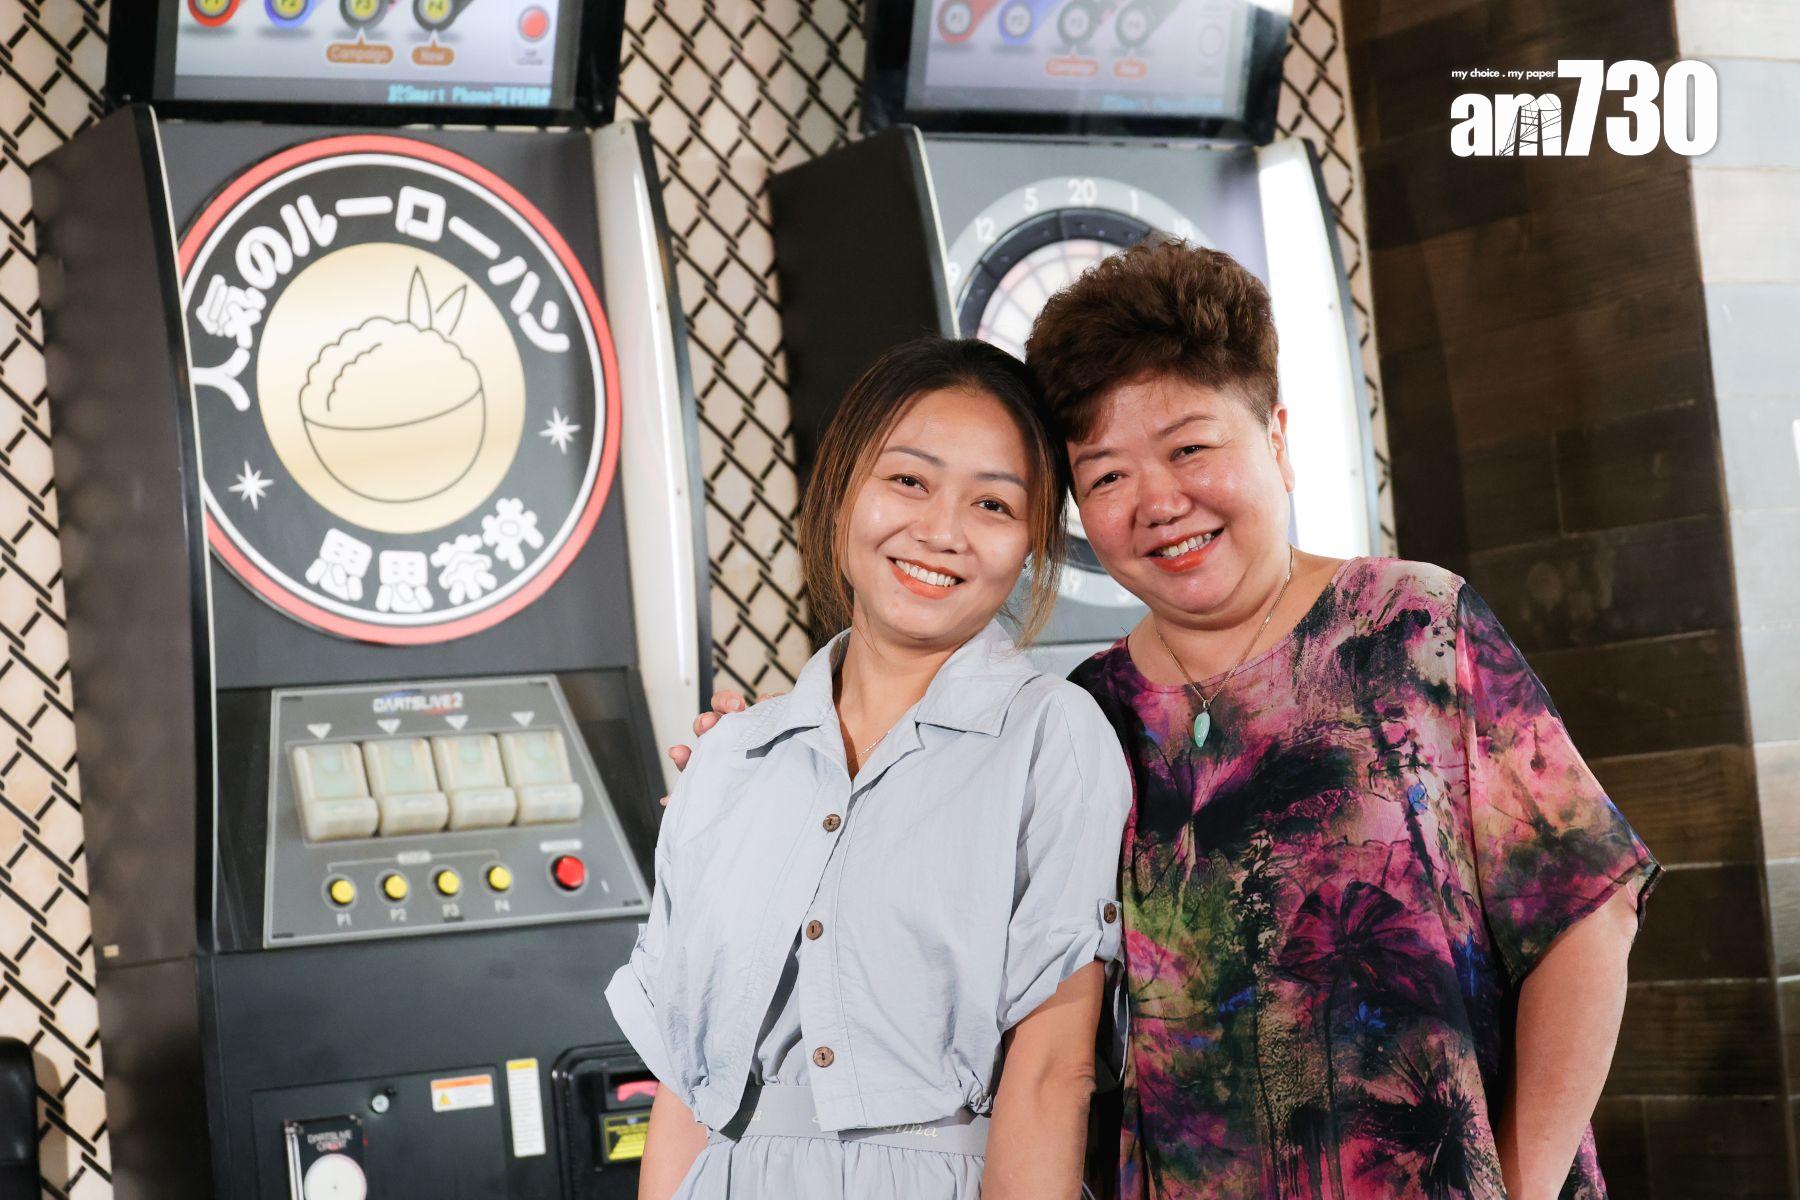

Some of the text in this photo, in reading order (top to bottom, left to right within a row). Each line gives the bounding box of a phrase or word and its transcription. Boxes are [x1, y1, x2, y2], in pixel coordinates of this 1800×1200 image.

[1024, 187, 1040, 213] 5
[1067, 178, 1098, 207] 20
[1129, 189, 1140, 216] 1
[975, 216, 996, 244] 12
[336, 913, 352, 927] P1
[390, 908, 407, 922] P2
